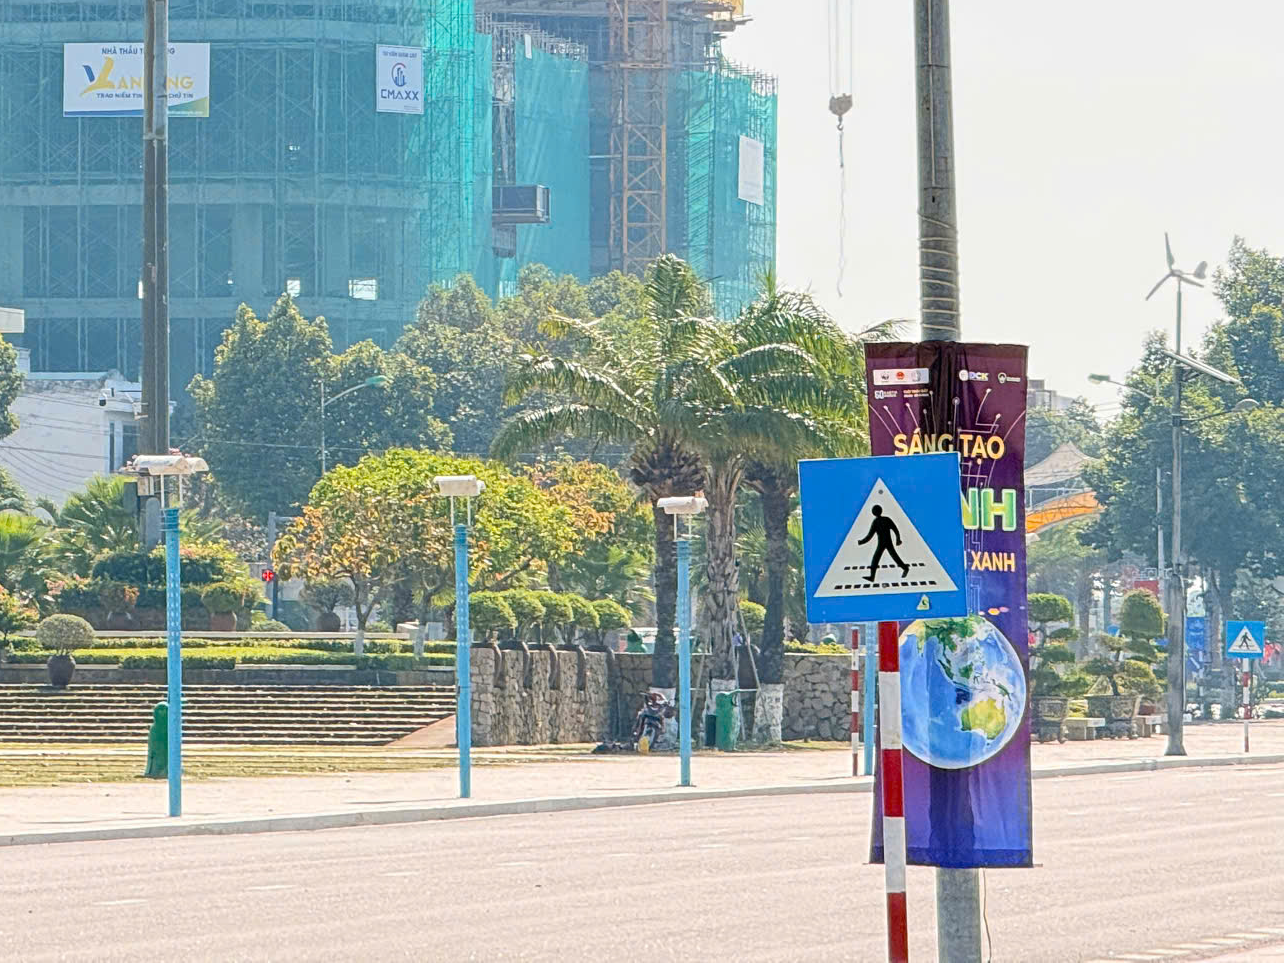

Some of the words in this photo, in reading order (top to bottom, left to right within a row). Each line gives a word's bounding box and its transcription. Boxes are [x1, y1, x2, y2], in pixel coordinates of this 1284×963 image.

[380, 88, 420, 101] CMAXX
[893, 427, 954, 456] SÁNG
[959, 434, 1005, 465] TẠO
[960, 486, 1017, 532] NH
[971, 550, 1016, 573] XANH
